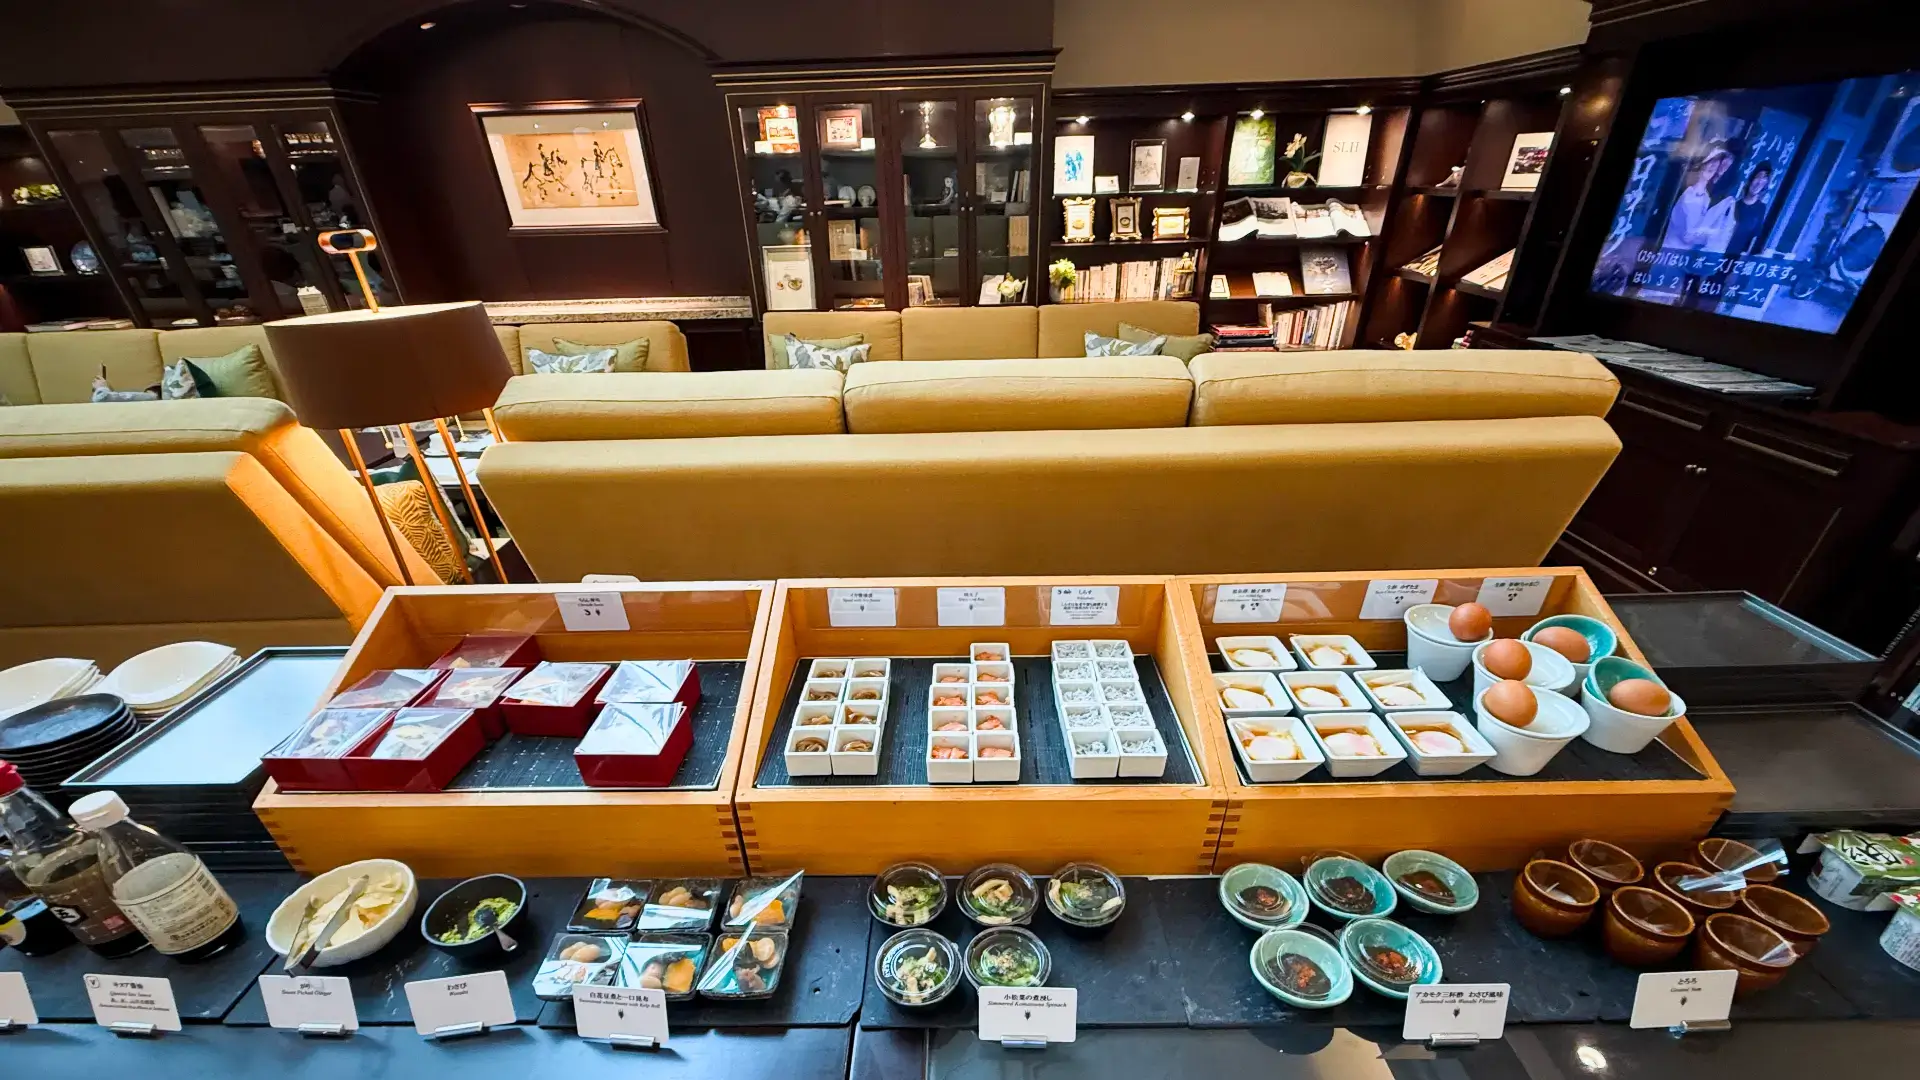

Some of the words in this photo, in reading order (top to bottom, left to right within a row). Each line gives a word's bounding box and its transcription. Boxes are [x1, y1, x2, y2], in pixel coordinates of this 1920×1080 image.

[1332, 141, 1360, 154] SLH
[1632, 271, 1652, 284] はい
[1656, 274, 1664, 287] 3
[1670, 276, 1680, 289] 2
[1685, 278, 1694, 291] 1
[1698, 281, 1722, 295] はい
[1677, 977, 1698, 985] とろろ
